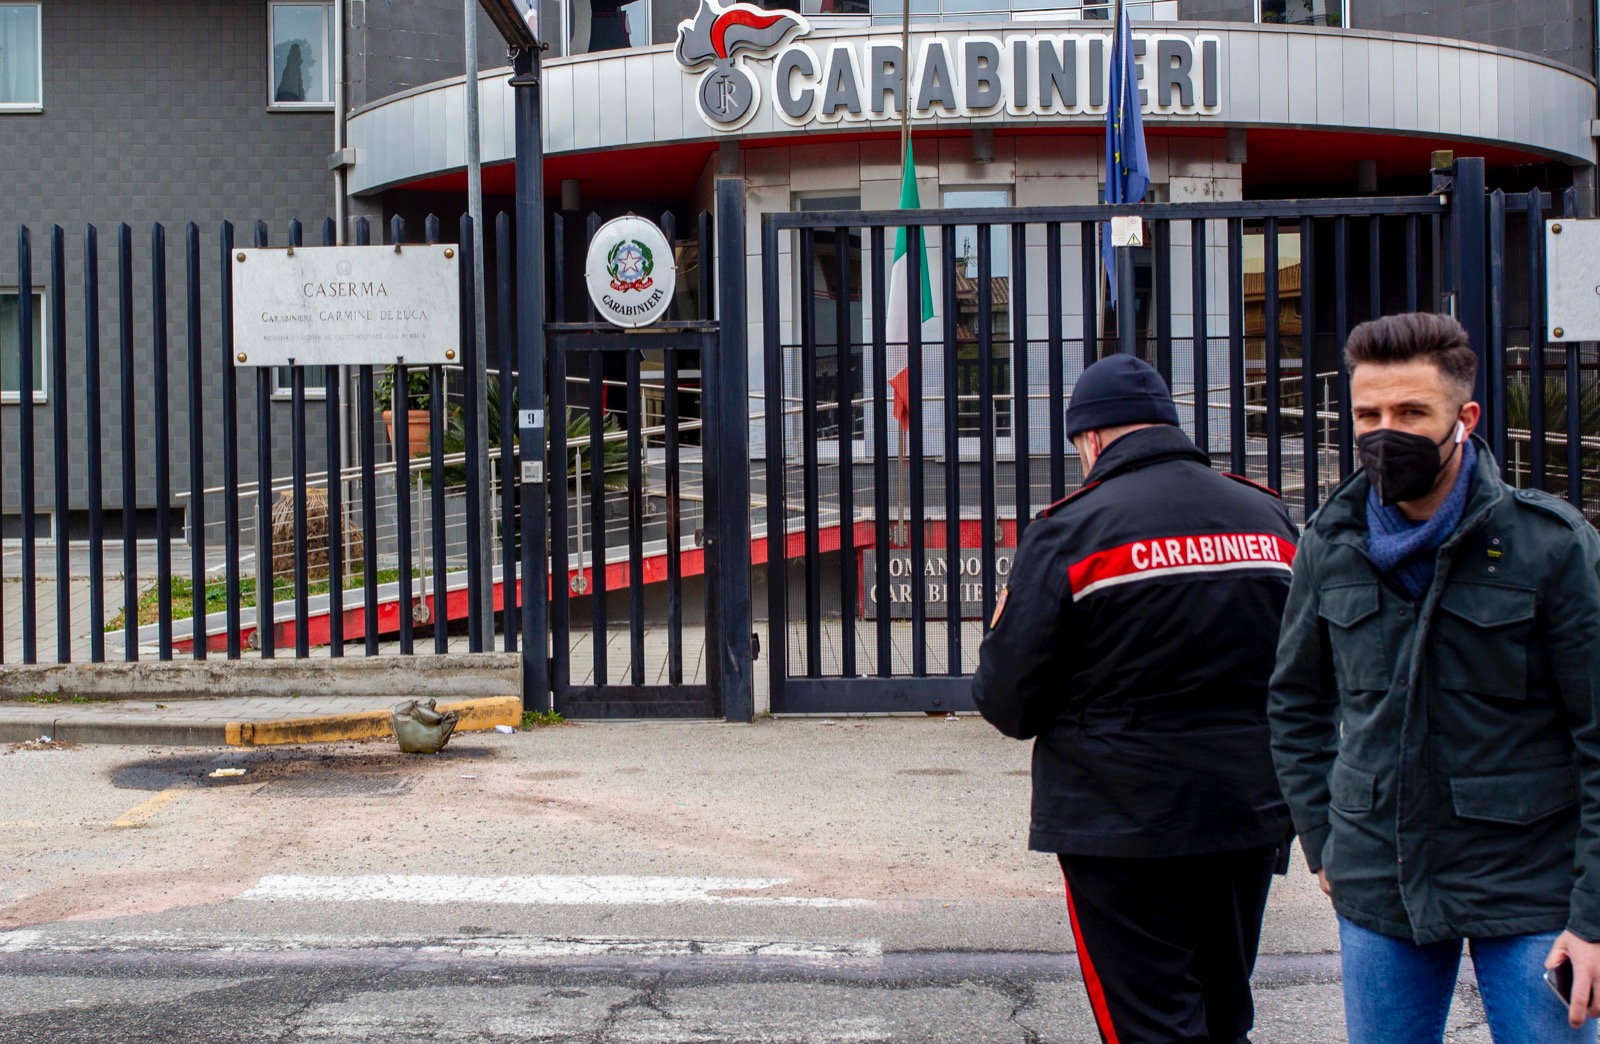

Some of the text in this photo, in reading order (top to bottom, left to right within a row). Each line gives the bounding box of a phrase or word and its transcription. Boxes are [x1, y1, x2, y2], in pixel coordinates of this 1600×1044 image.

[303, 282, 388, 298] CASERMA
[602, 288, 664, 316] CARABINIERI
[319, 310, 372, 322] CARMINE
[527, 412, 535, 425] 9
[1131, 534, 1281, 570] CARABINIERI
